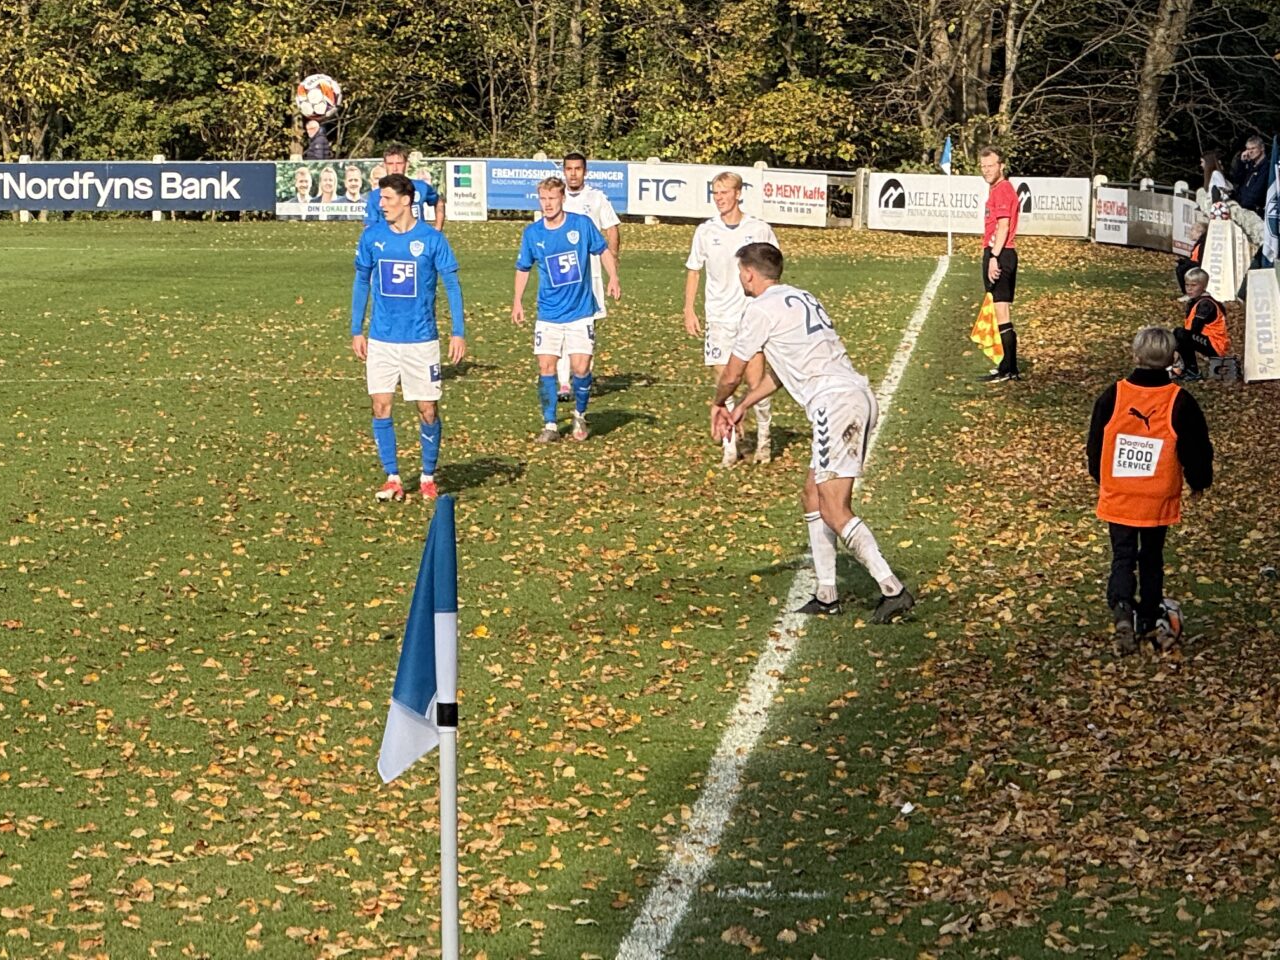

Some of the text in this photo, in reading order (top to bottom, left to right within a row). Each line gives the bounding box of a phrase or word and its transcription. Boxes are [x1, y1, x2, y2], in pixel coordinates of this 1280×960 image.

[3, 170, 241, 208] Nordfyns Bank
[639, 179, 686, 202] FTC
[775, 184, 826, 200] MENY kaffe
[558, 254, 577, 274] 5E
[391, 263, 414, 284] 5E
[1119, 437, 1154, 449] Dagrofa
[1118, 448, 1153, 463] FOOD
[1116, 460, 1151, 471] SERVICE
